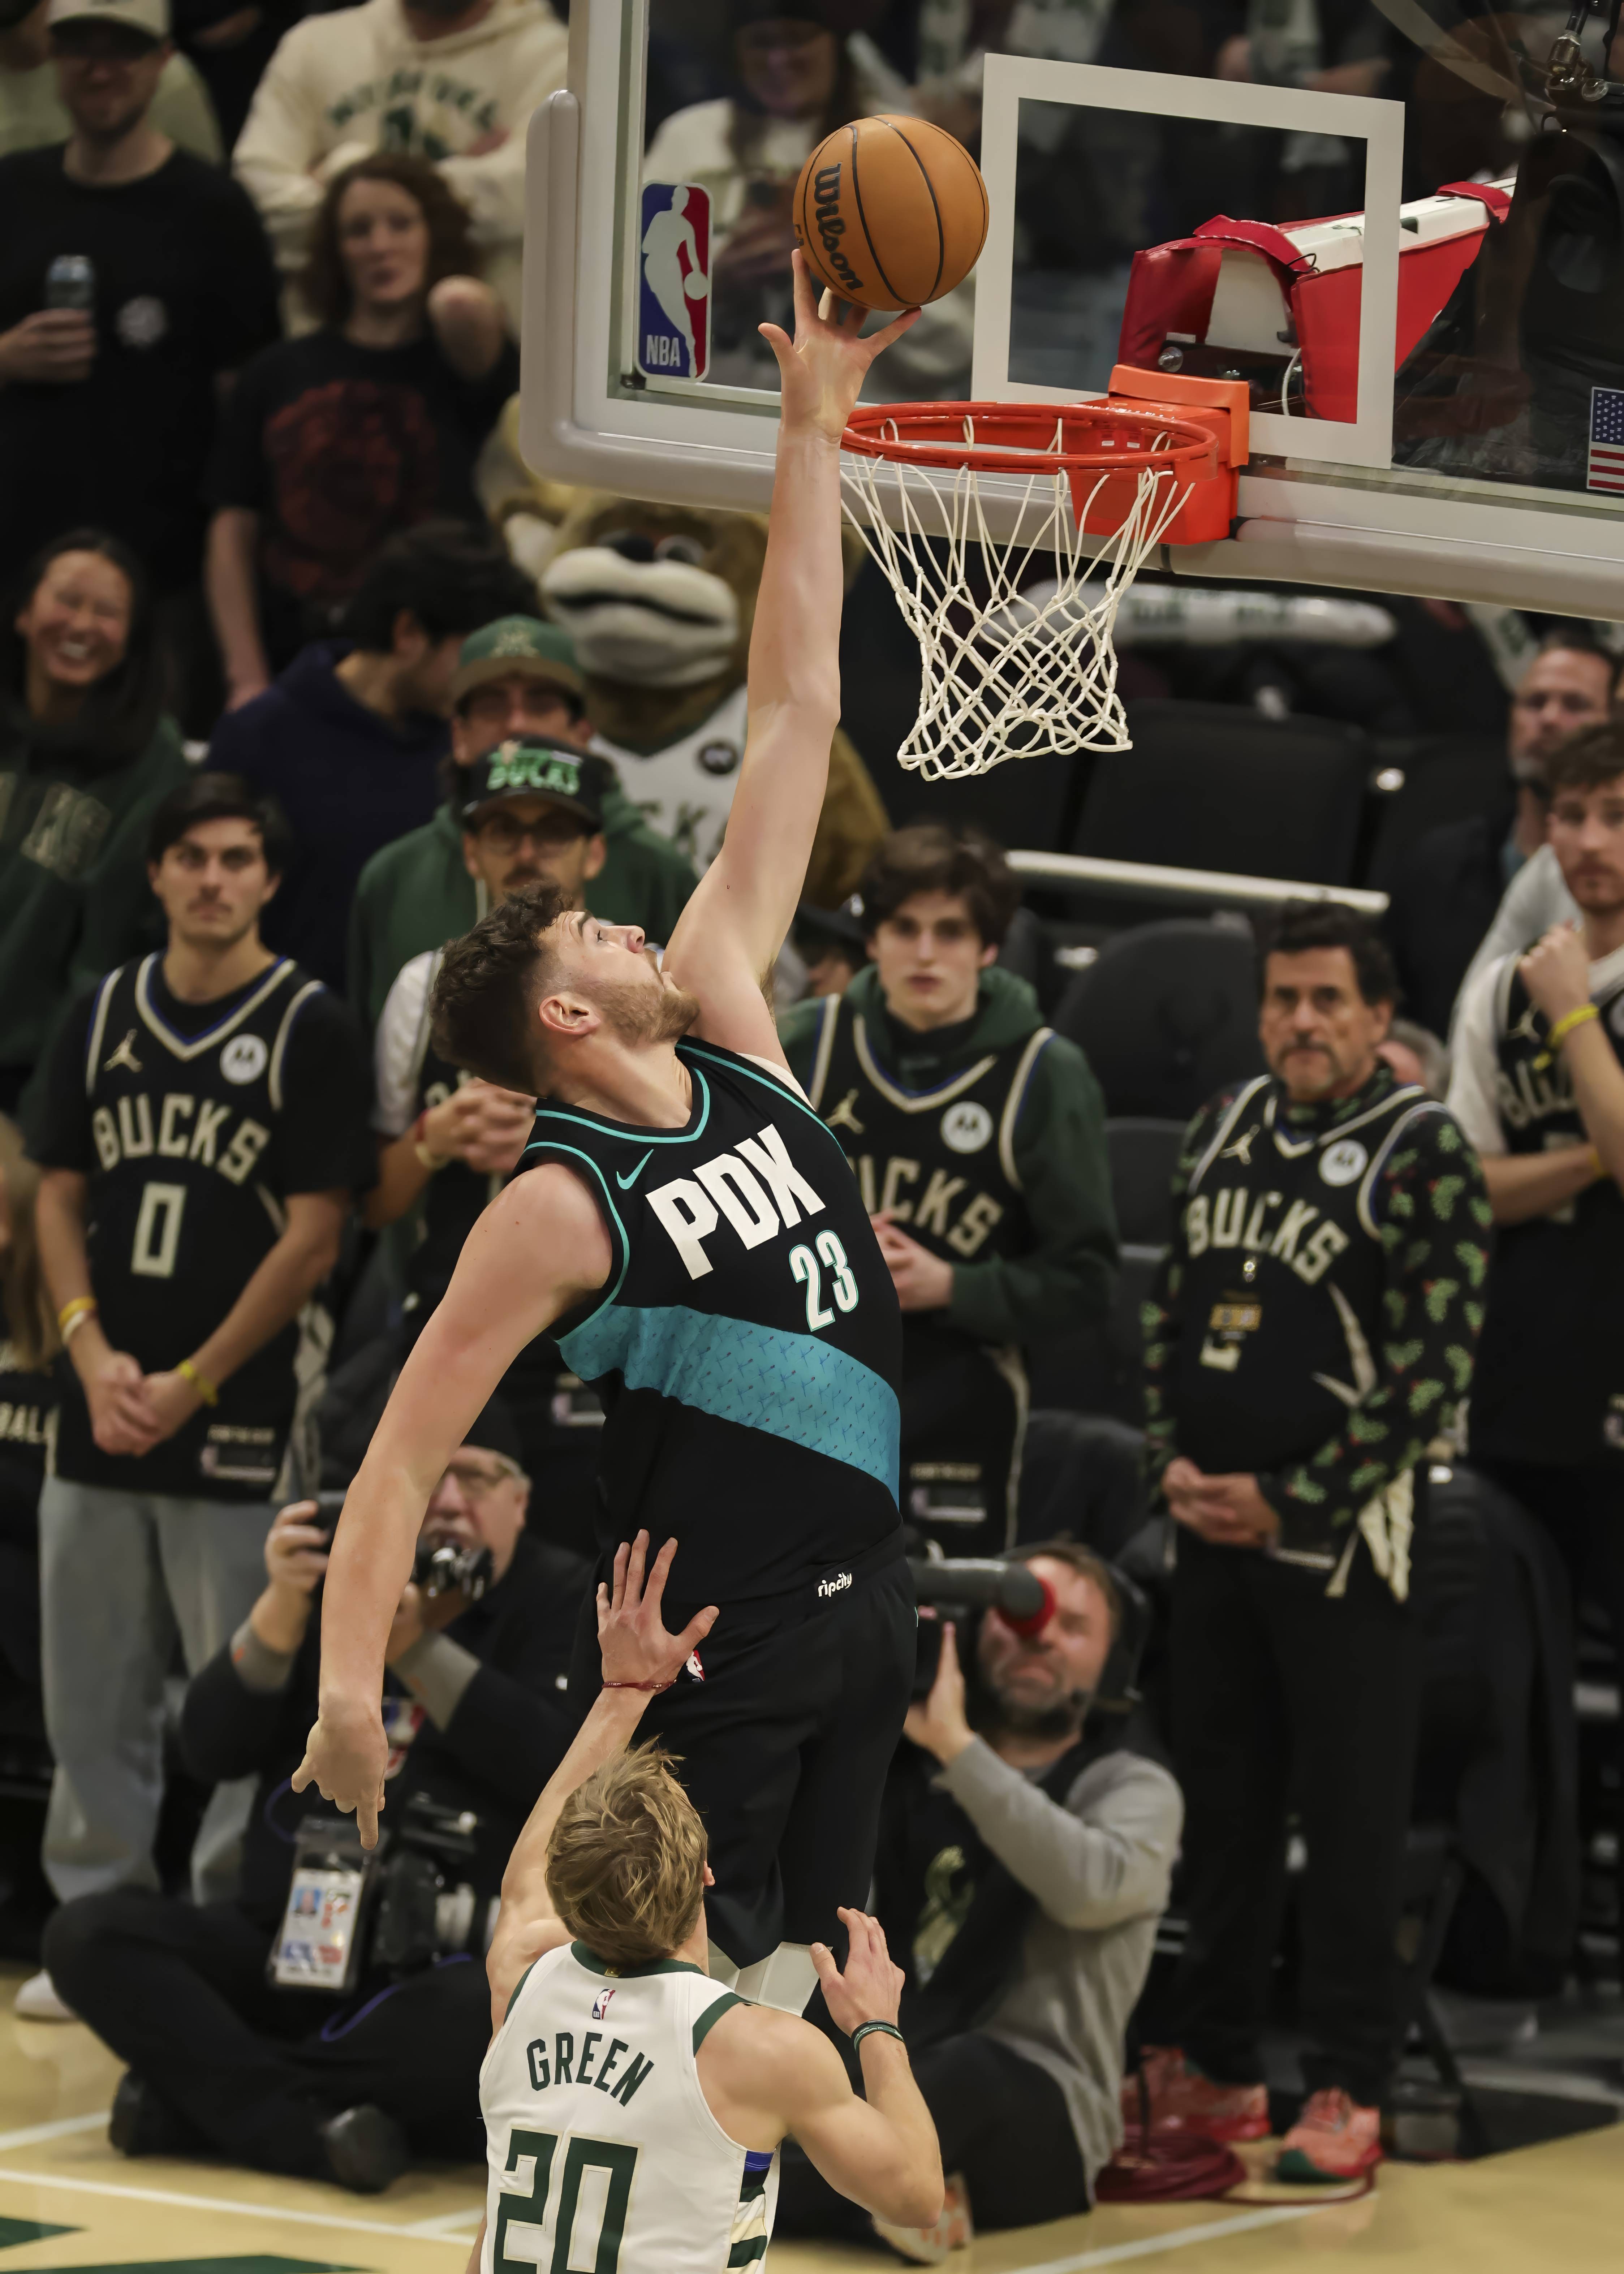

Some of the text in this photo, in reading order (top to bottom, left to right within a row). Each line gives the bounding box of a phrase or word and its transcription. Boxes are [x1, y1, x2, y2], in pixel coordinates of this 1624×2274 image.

[814, 162, 864, 290] Wilson
[646, 334, 681, 367] NBA
[92, 1093, 270, 1186] BUCKS
[130, 1181, 186, 1279] 0
[645, 1123, 826, 1280] PDX
[1186, 1187, 1351, 1286] BUCKS
[789, 1229, 858, 1332] 23
[526, 2032, 655, 2107] GREEN
[494, 2126, 645, 2274] 20
